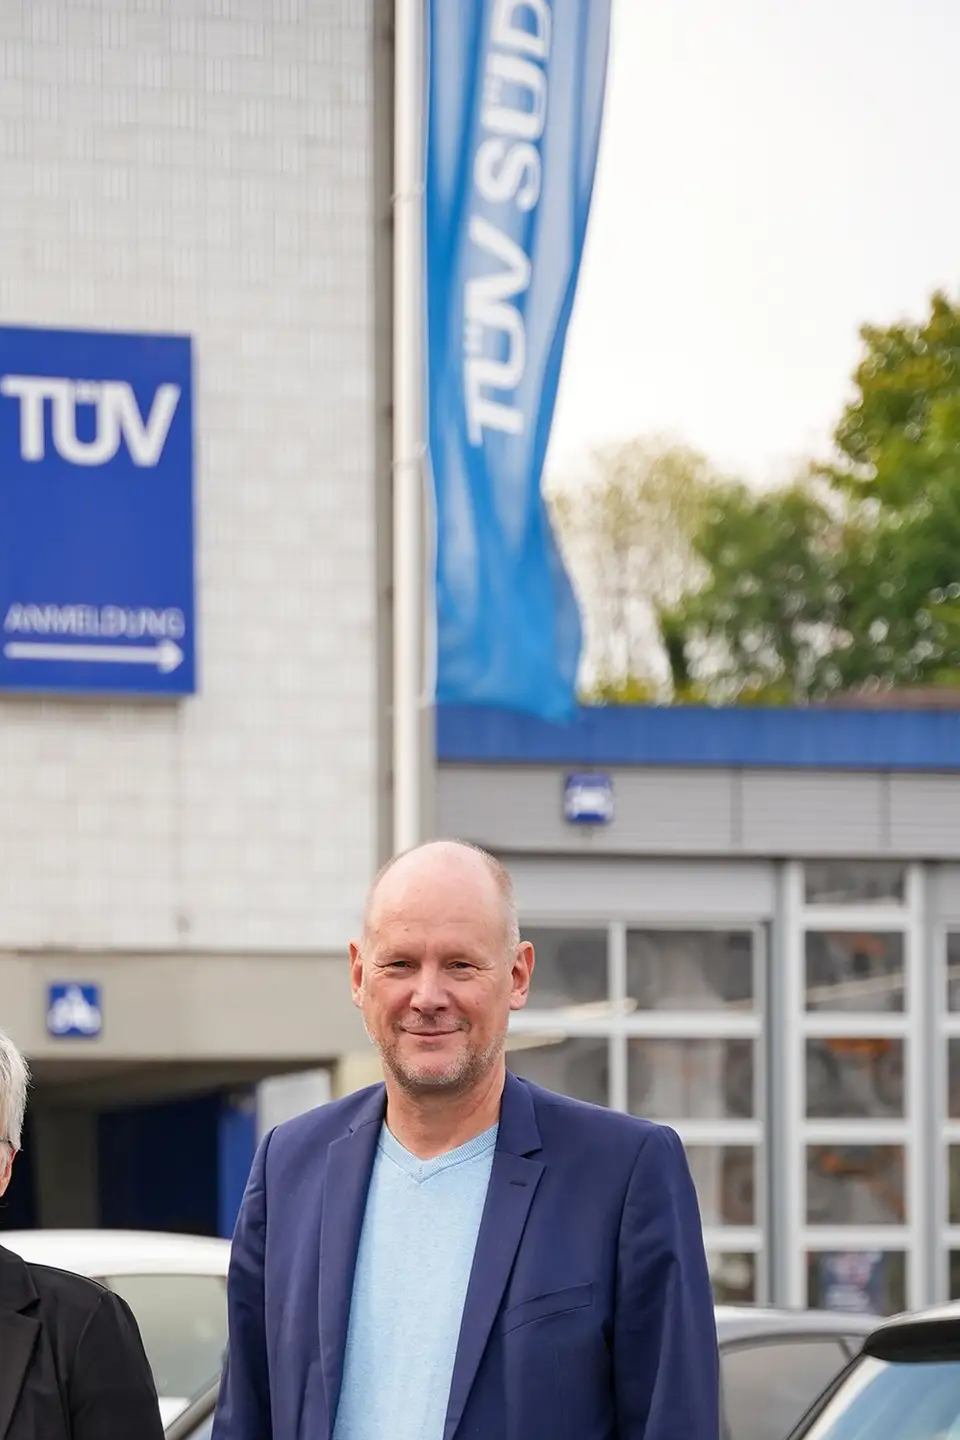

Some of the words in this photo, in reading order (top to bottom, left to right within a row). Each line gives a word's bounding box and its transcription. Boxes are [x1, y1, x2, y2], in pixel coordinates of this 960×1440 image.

[464, 216, 531, 446] TÜV
[0, 373, 181, 467] TÜV
[3, 602, 186, 639] ANMELDUNG
